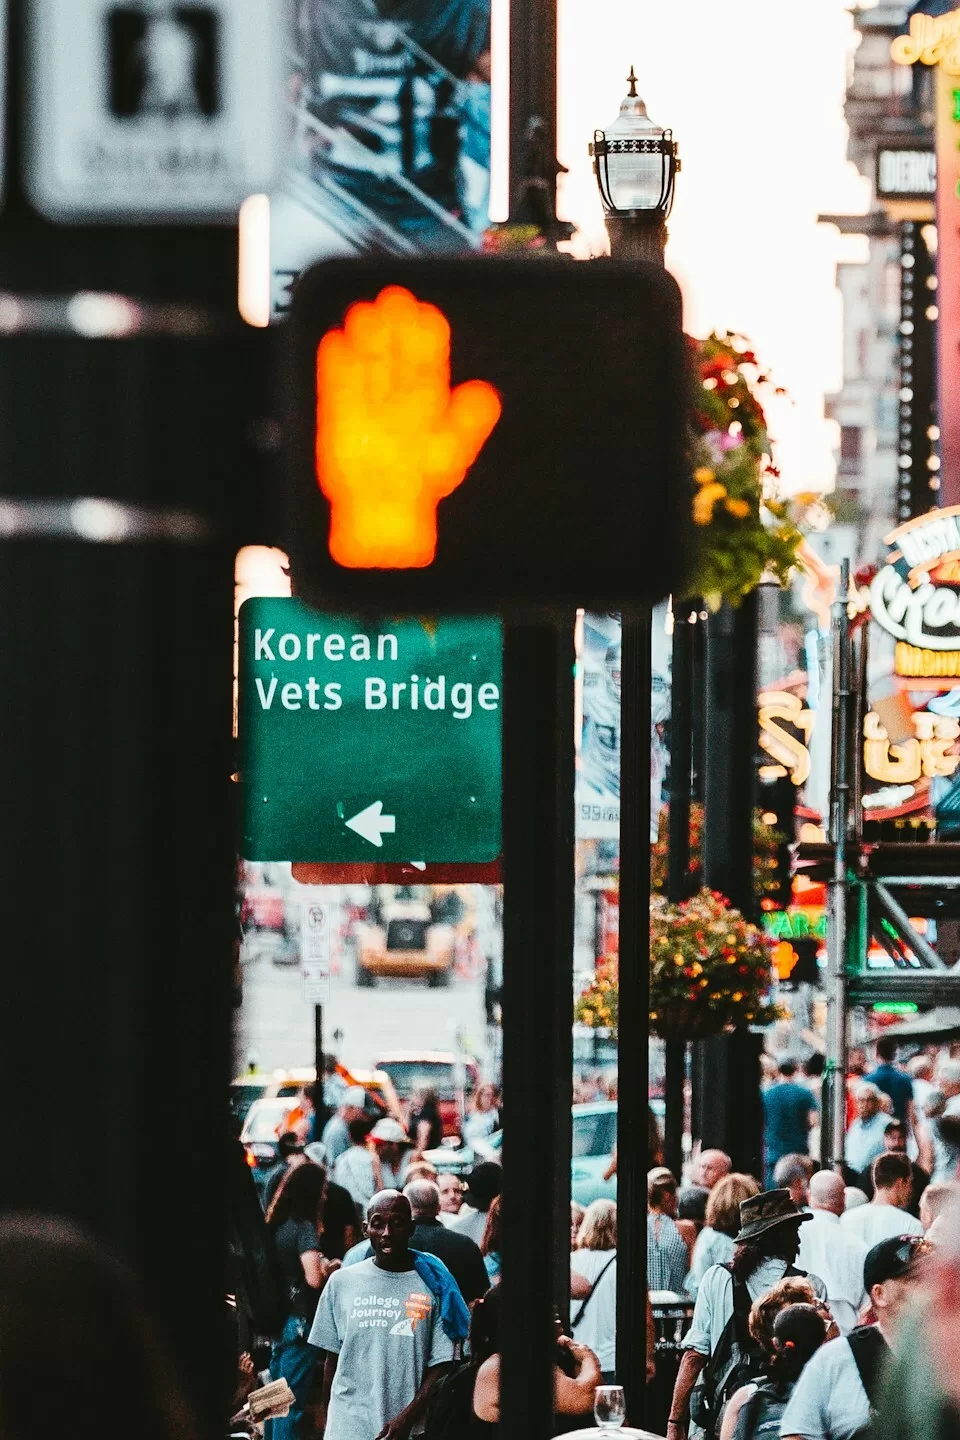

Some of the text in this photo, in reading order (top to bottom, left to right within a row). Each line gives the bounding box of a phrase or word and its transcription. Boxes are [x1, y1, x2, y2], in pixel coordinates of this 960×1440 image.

[253, 628, 400, 662] Korean
[255, 675, 500, 720] Vets Bridge
[353, 1295, 400, 1308] College
[350, 1308, 401, 1320] Journey
[359, 1319, 388, 1328] at UTD
